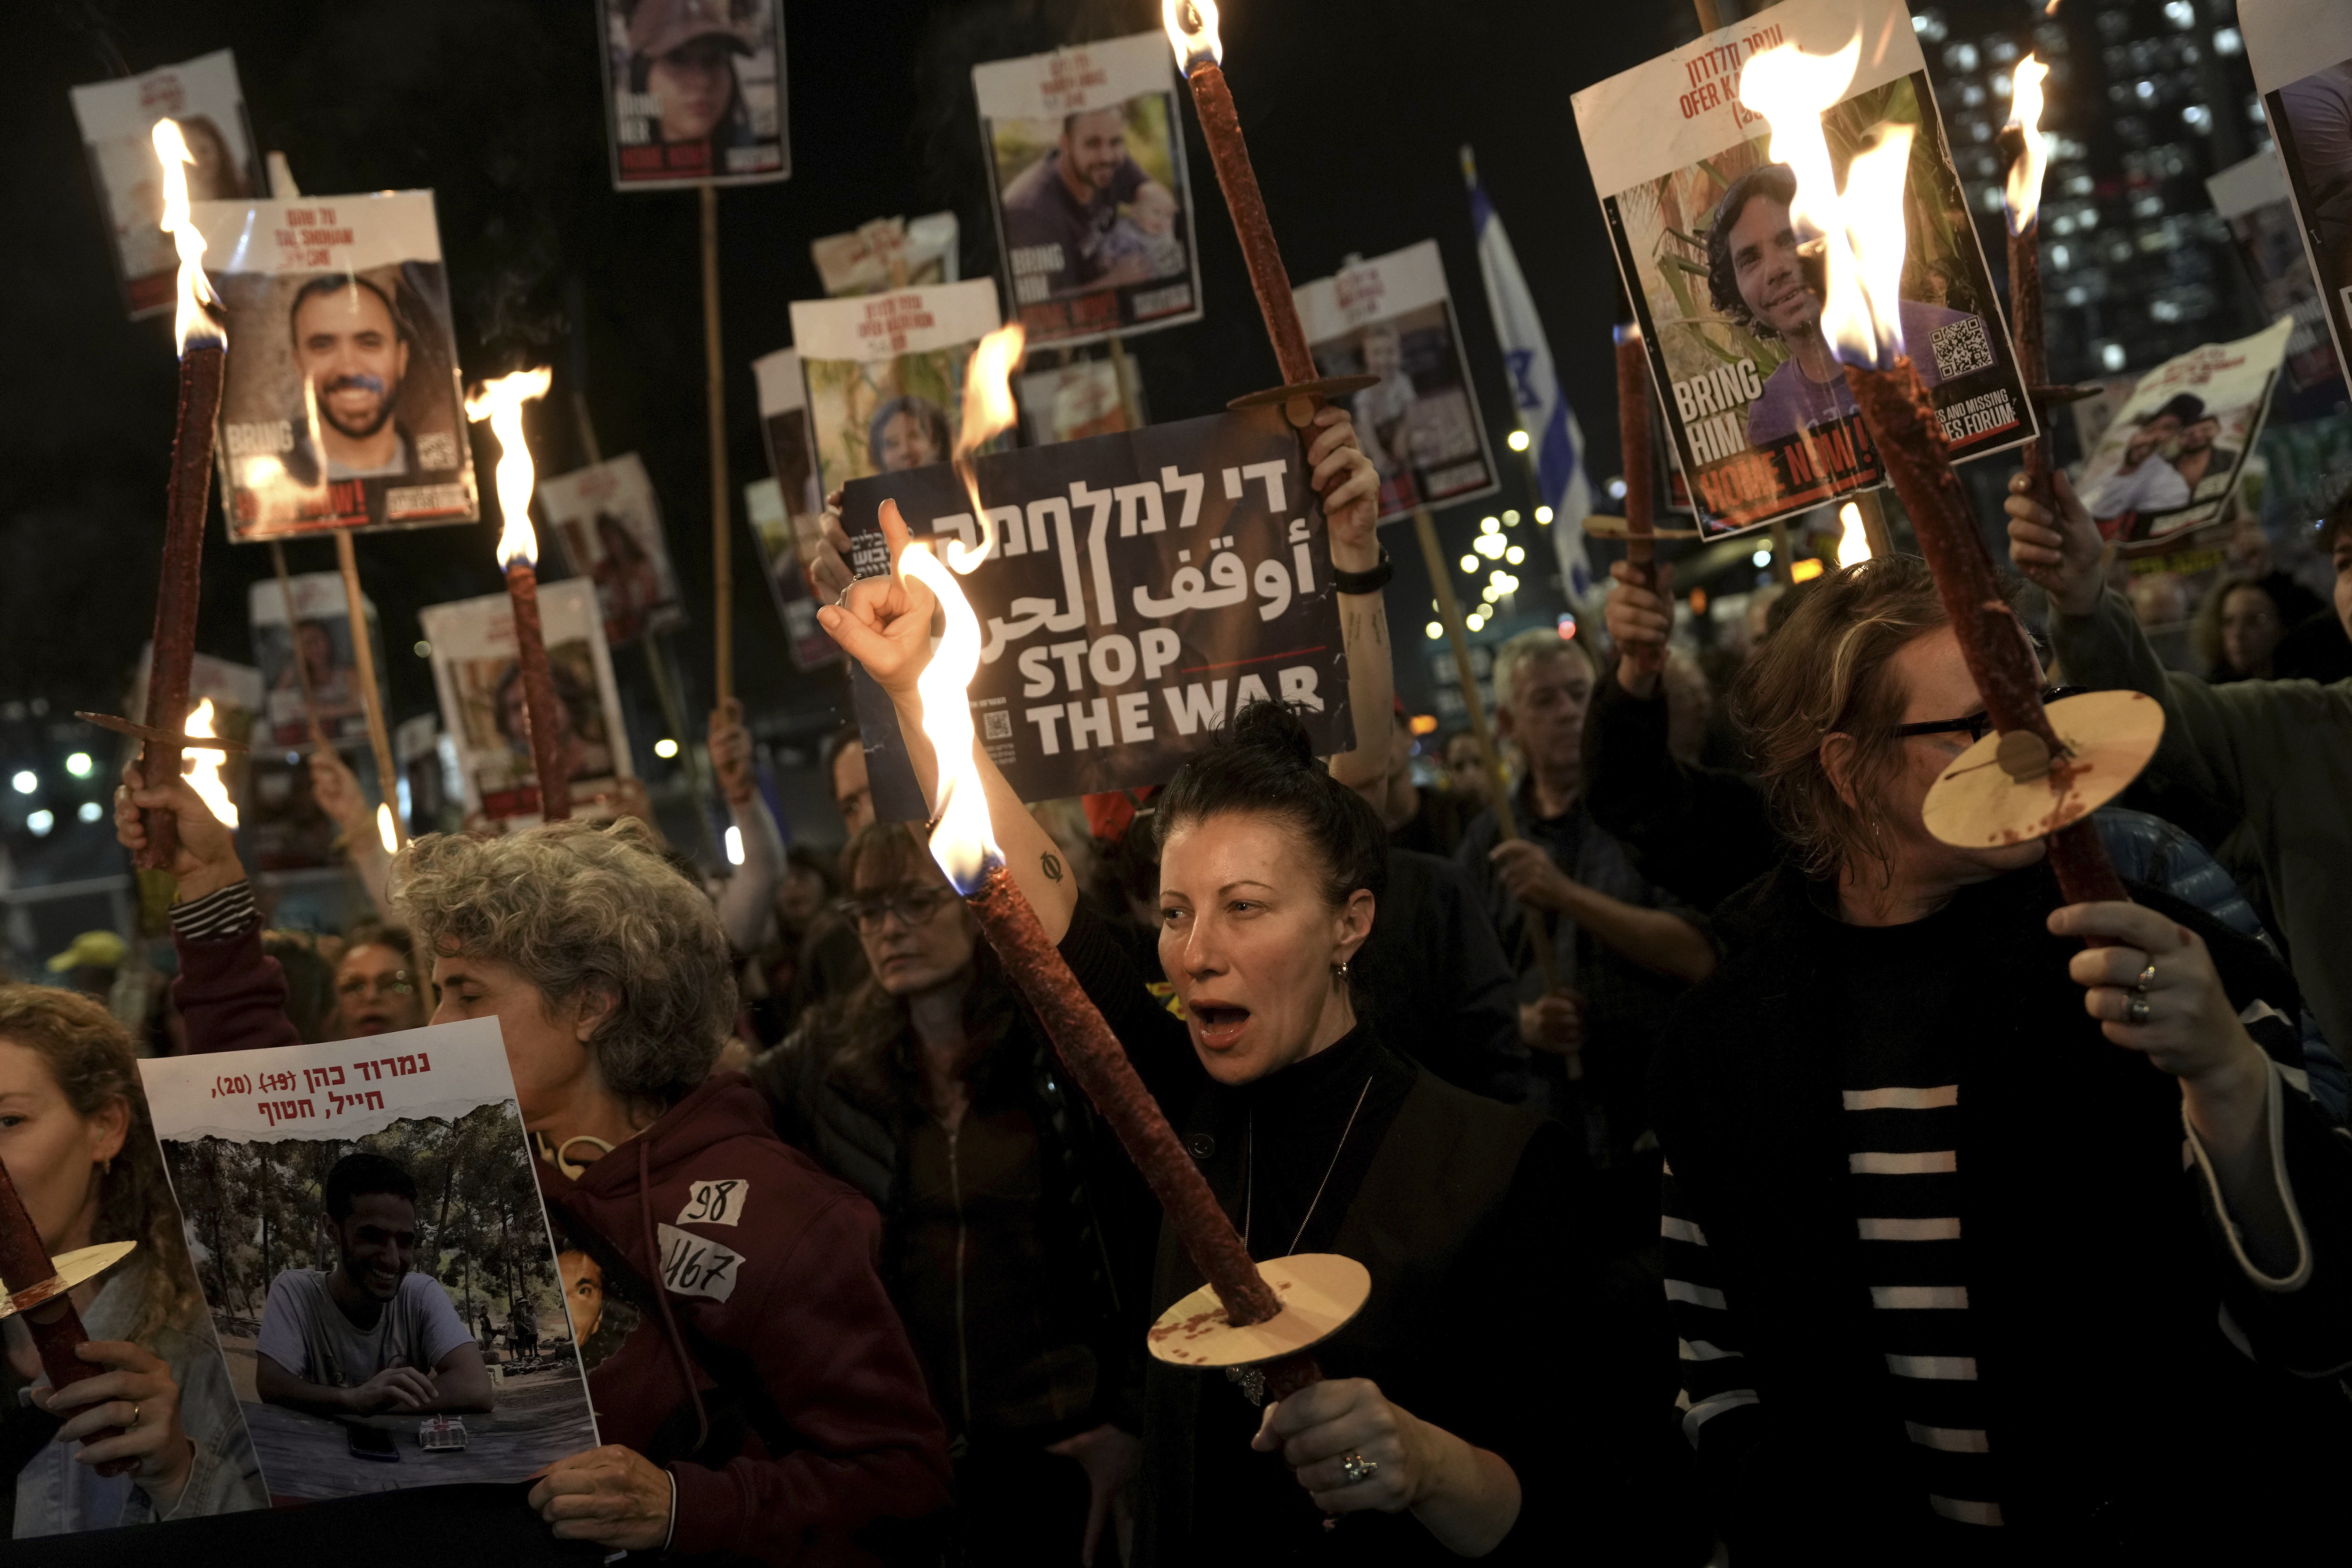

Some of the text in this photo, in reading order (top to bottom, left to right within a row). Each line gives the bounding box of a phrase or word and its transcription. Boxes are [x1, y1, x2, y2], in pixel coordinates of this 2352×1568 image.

[1680, 83, 1721, 119] OFER
[1672, 358, 1763, 423] BRING
[1947, 402, 1966, 421] AND
[1965, 388, 2009, 416] MISSING
[1685, 411, 1746, 467] HIM
[1963, 402, 2016, 437] FORUM
[1221, 459, 1288, 513] די
[1700, 450, 1786, 513] HOME
[1132, 517, 1316, 622] أوقف
[1017, 627, 1181, 699] STOP
[1025, 665, 1325, 756] THE WAR
[303, 1066, 345, 1094] כהן
[353, 1052, 431, 1081] נמרוד
[258, 1090, 385, 1127] חייל, חטוף
[687, 1180, 739, 1222] 98
[665, 1238, 735, 1291] 467
